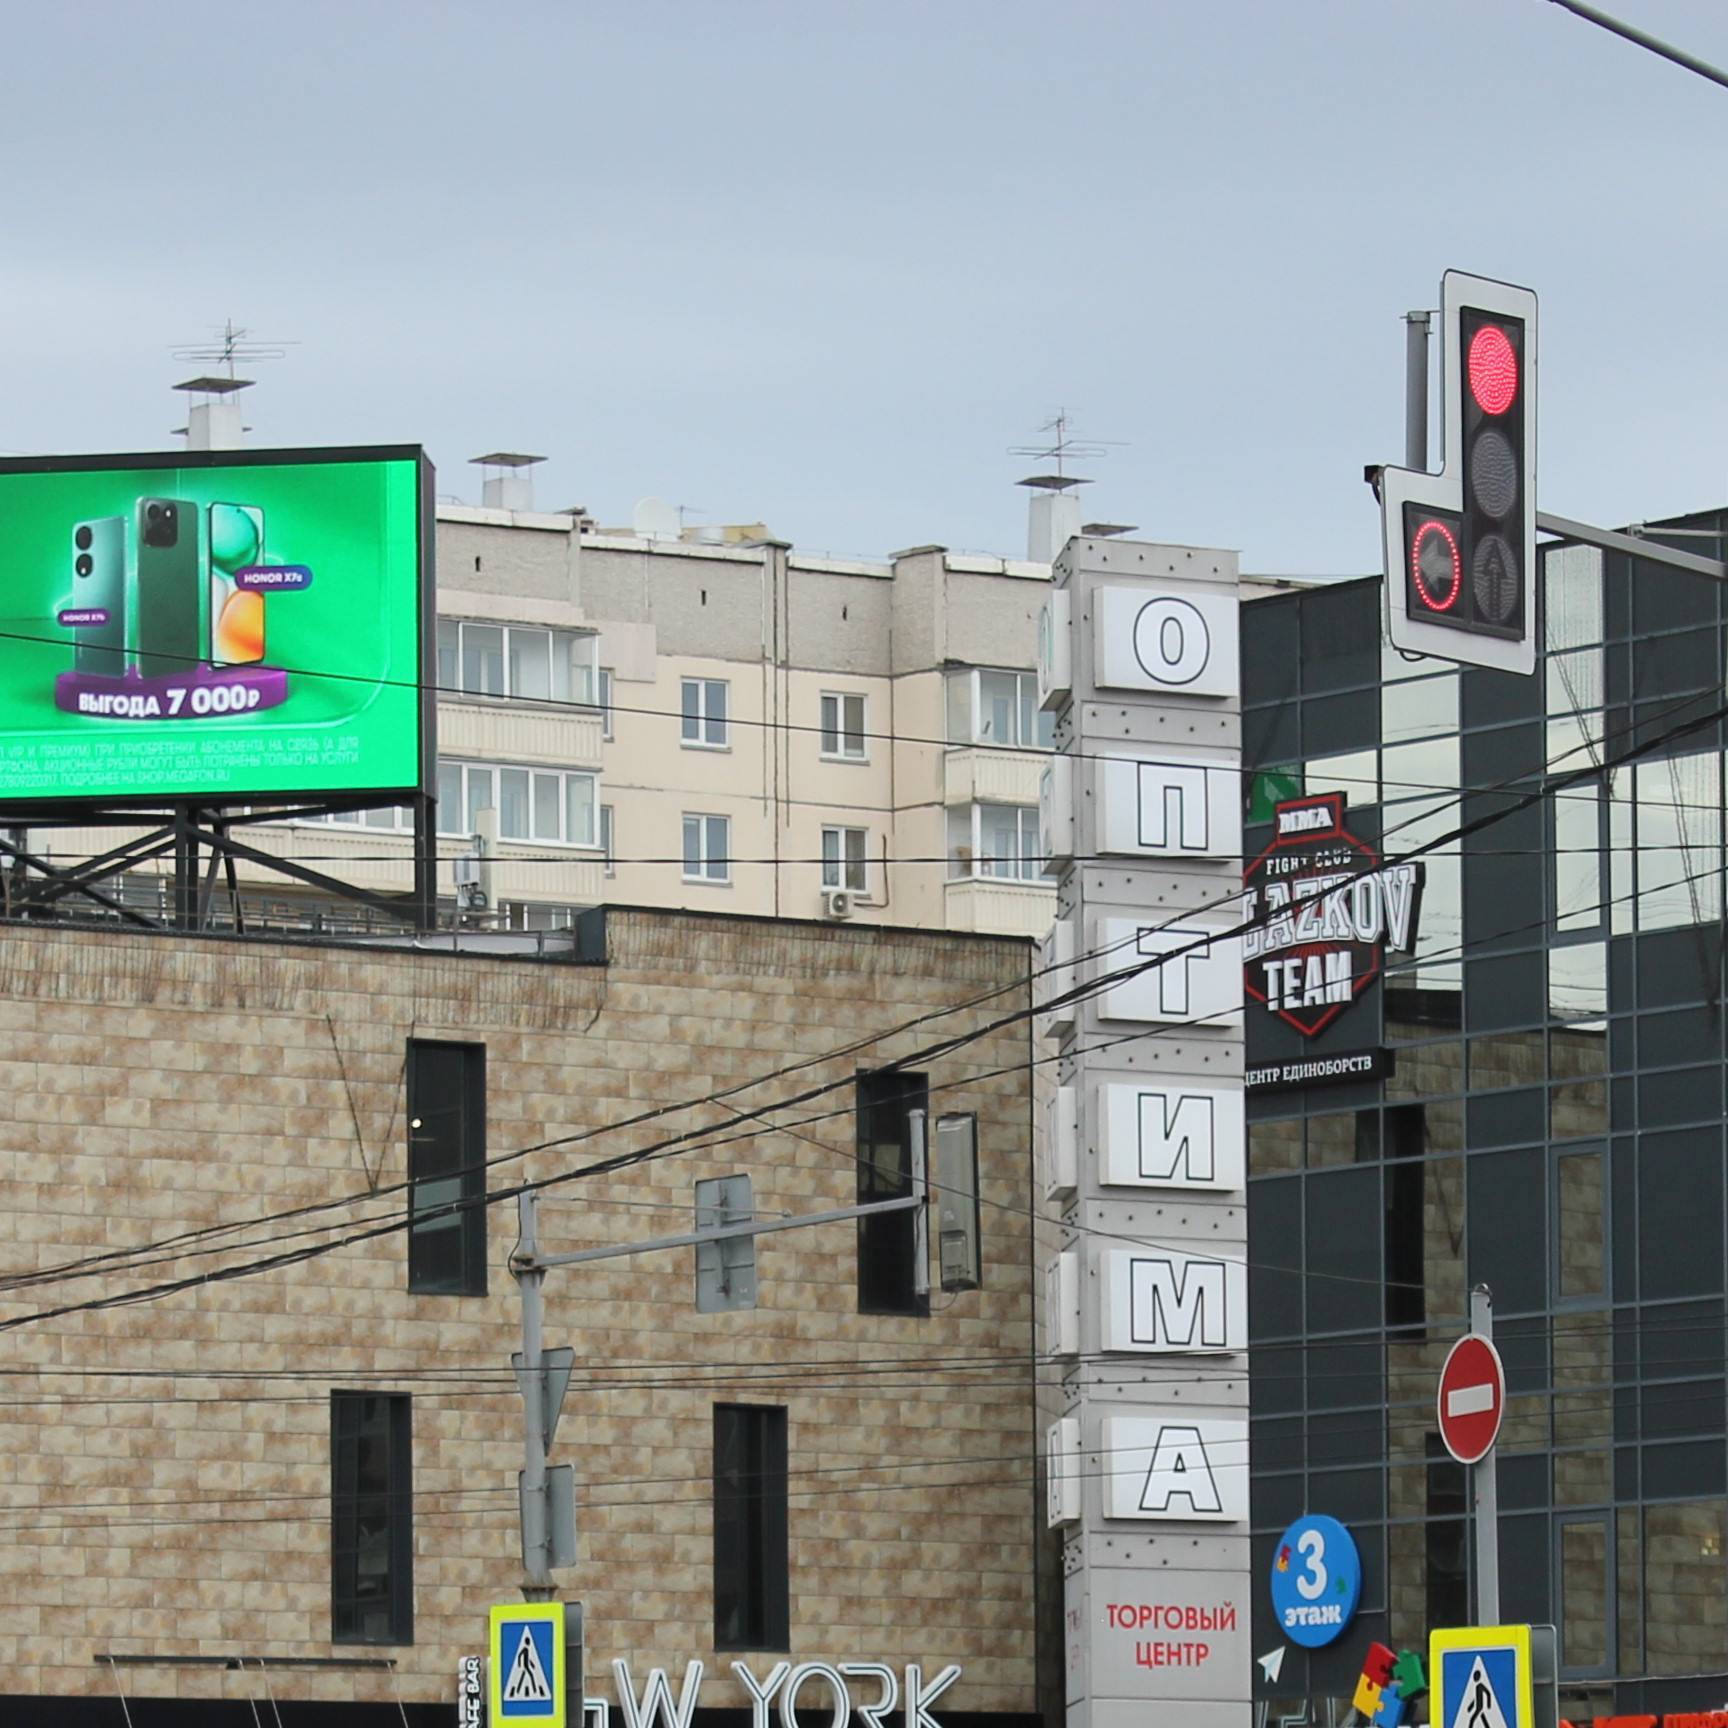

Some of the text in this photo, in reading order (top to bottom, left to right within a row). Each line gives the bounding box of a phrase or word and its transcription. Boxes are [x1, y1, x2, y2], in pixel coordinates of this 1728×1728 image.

[243, 572, 283, 584] HONOR
[77, 692, 162, 719] ВЫГОДА
[165, 687, 189, 716] 7
[1279, 807, 1334, 835] MMA
[1262, 951, 1353, 1012] TEAM
[1282, 1055, 1373, 1083] ЕДИНОБОРСТВ
[1296, 1528, 1329, 1600] 3
[1106, 1602, 1237, 1632] ТОРГОВЫЙ
[1284, 1602, 1343, 1625] этаж
[1136, 1641, 1210, 1669] ЦЕНТР
[467, 1656, 480, 1693] BAR
